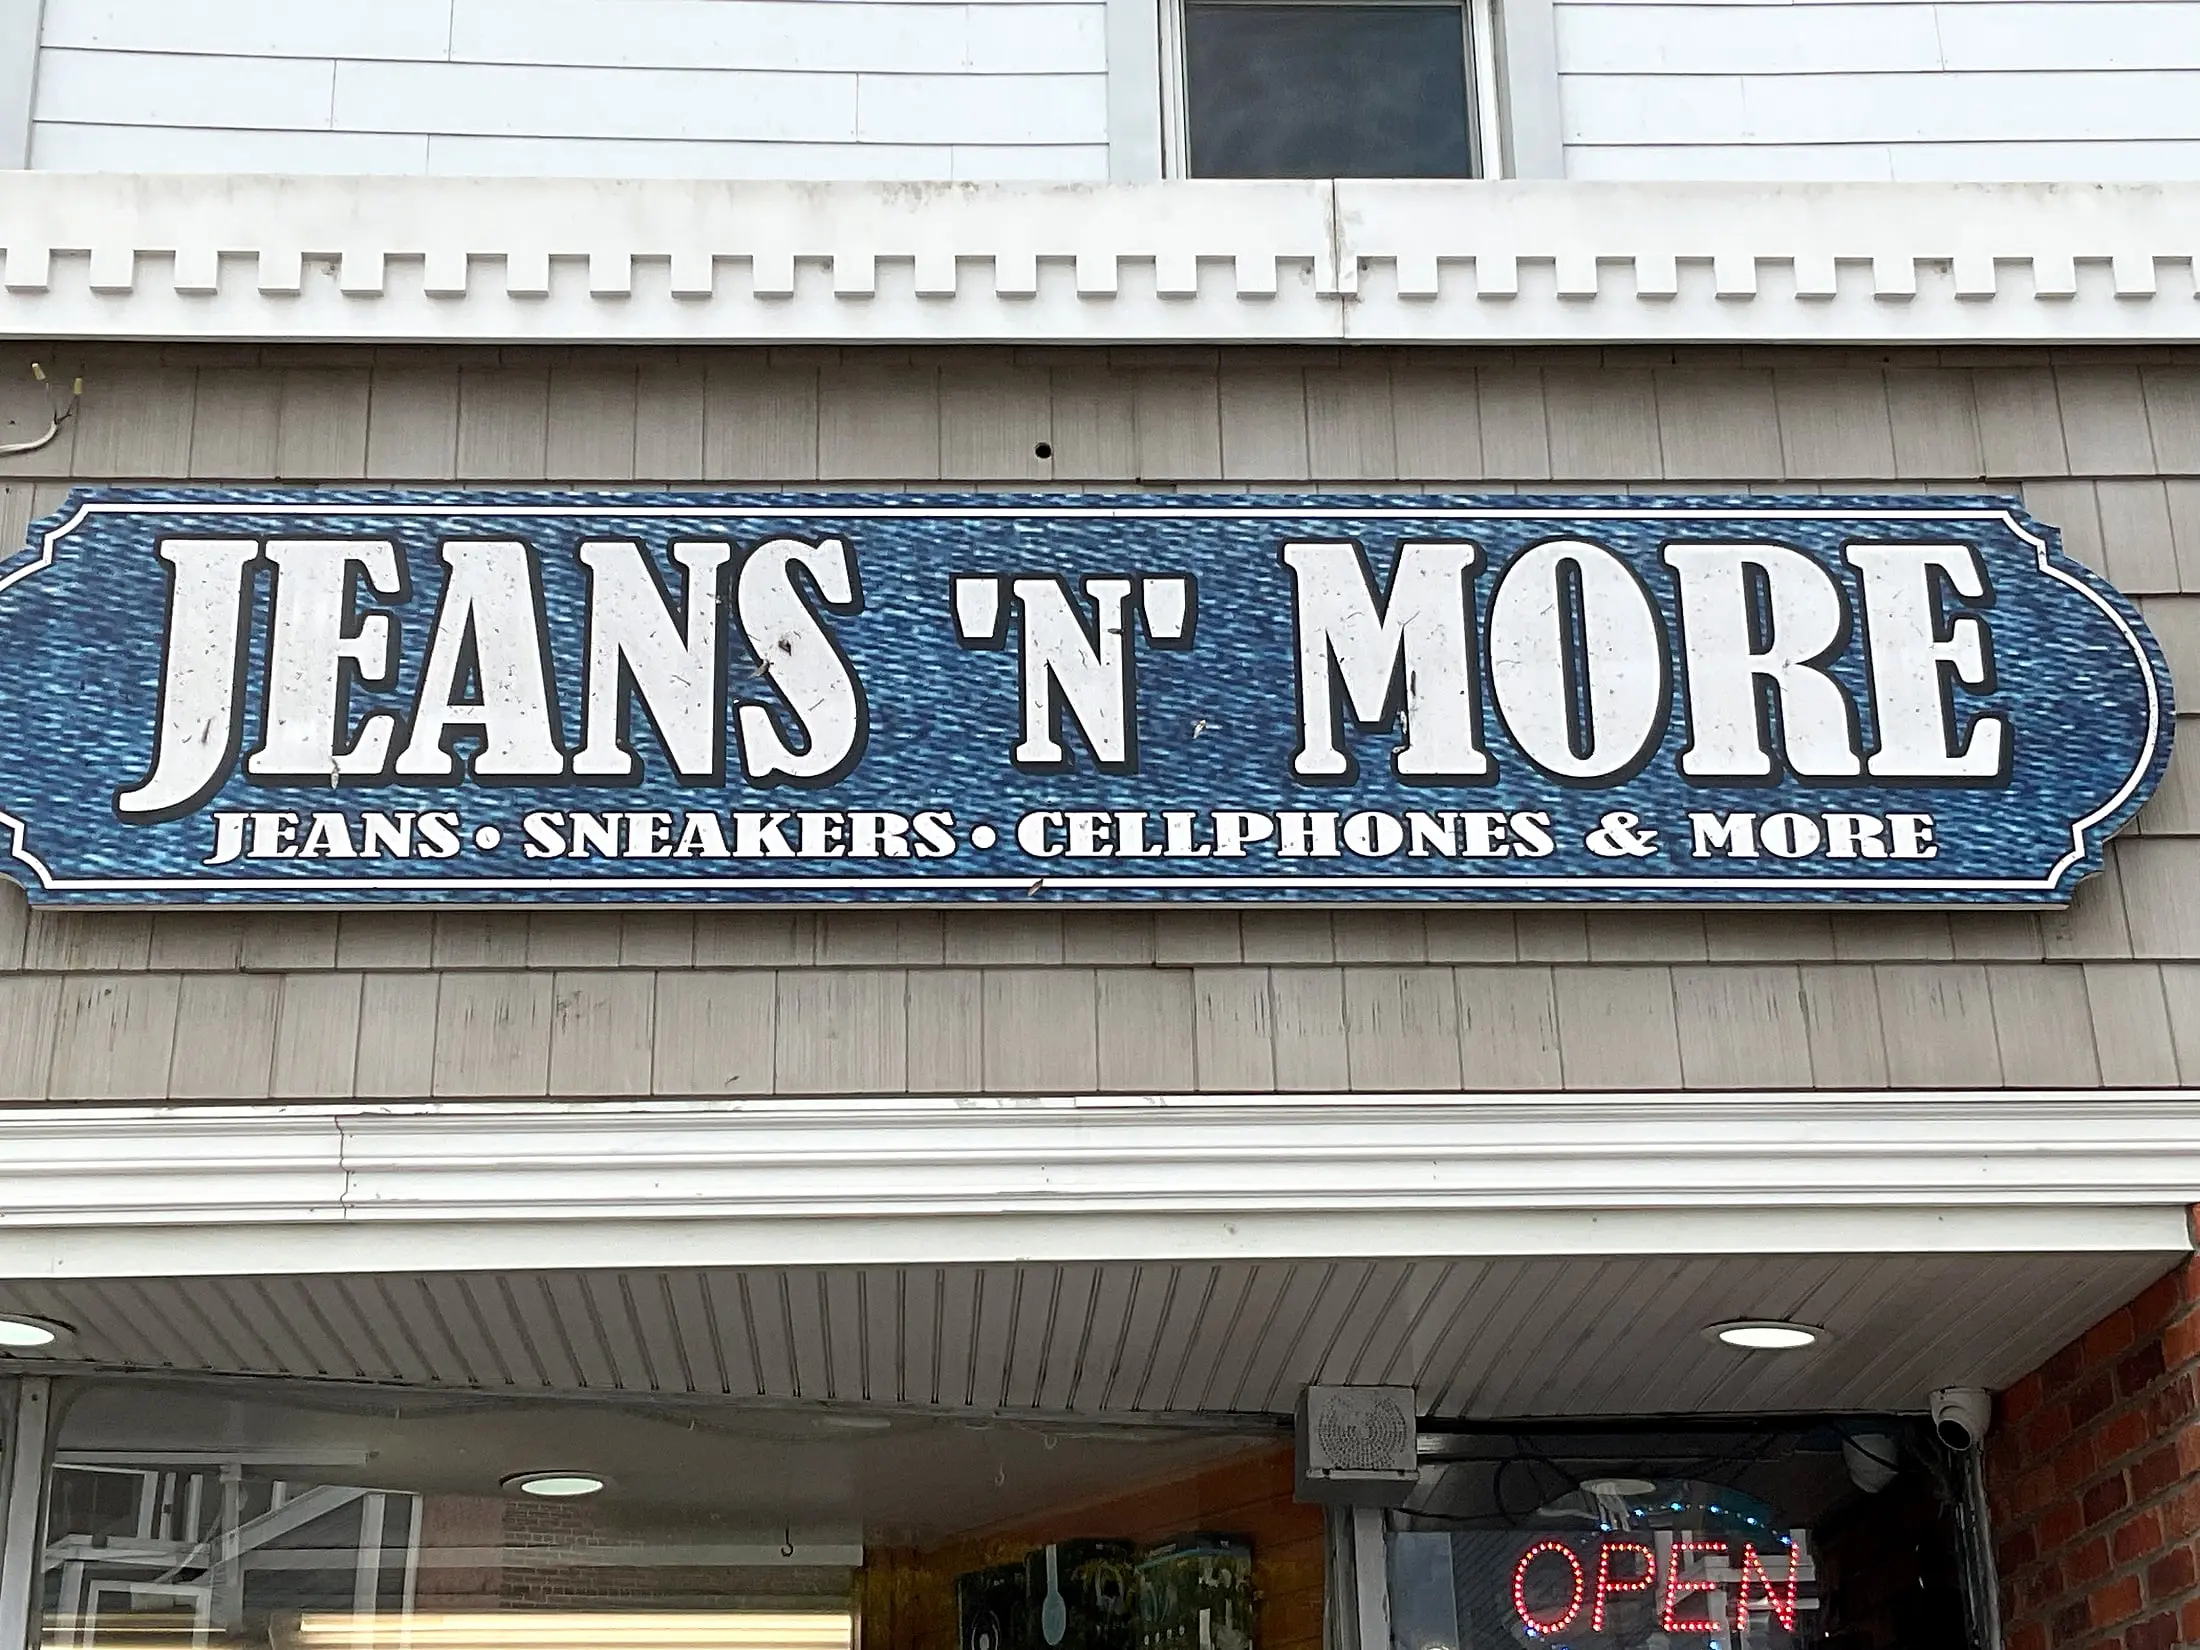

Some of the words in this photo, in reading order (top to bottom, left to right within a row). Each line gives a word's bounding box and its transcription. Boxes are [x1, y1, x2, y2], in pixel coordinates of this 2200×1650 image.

[118, 538, 858, 813] JEANS
[955, 577, 1187, 764] 'N'
[1282, 539, 2003, 779] MORE
[202, 811, 461, 866] JEANS
[522, 811, 957, 859] SNEAKERS
[1016, 811, 1555, 859] CELLPHONES
[1584, 811, 1659, 858] &
[1686, 812, 1939, 859] MORE
[1512, 1541, 1801, 1634] OPEN
